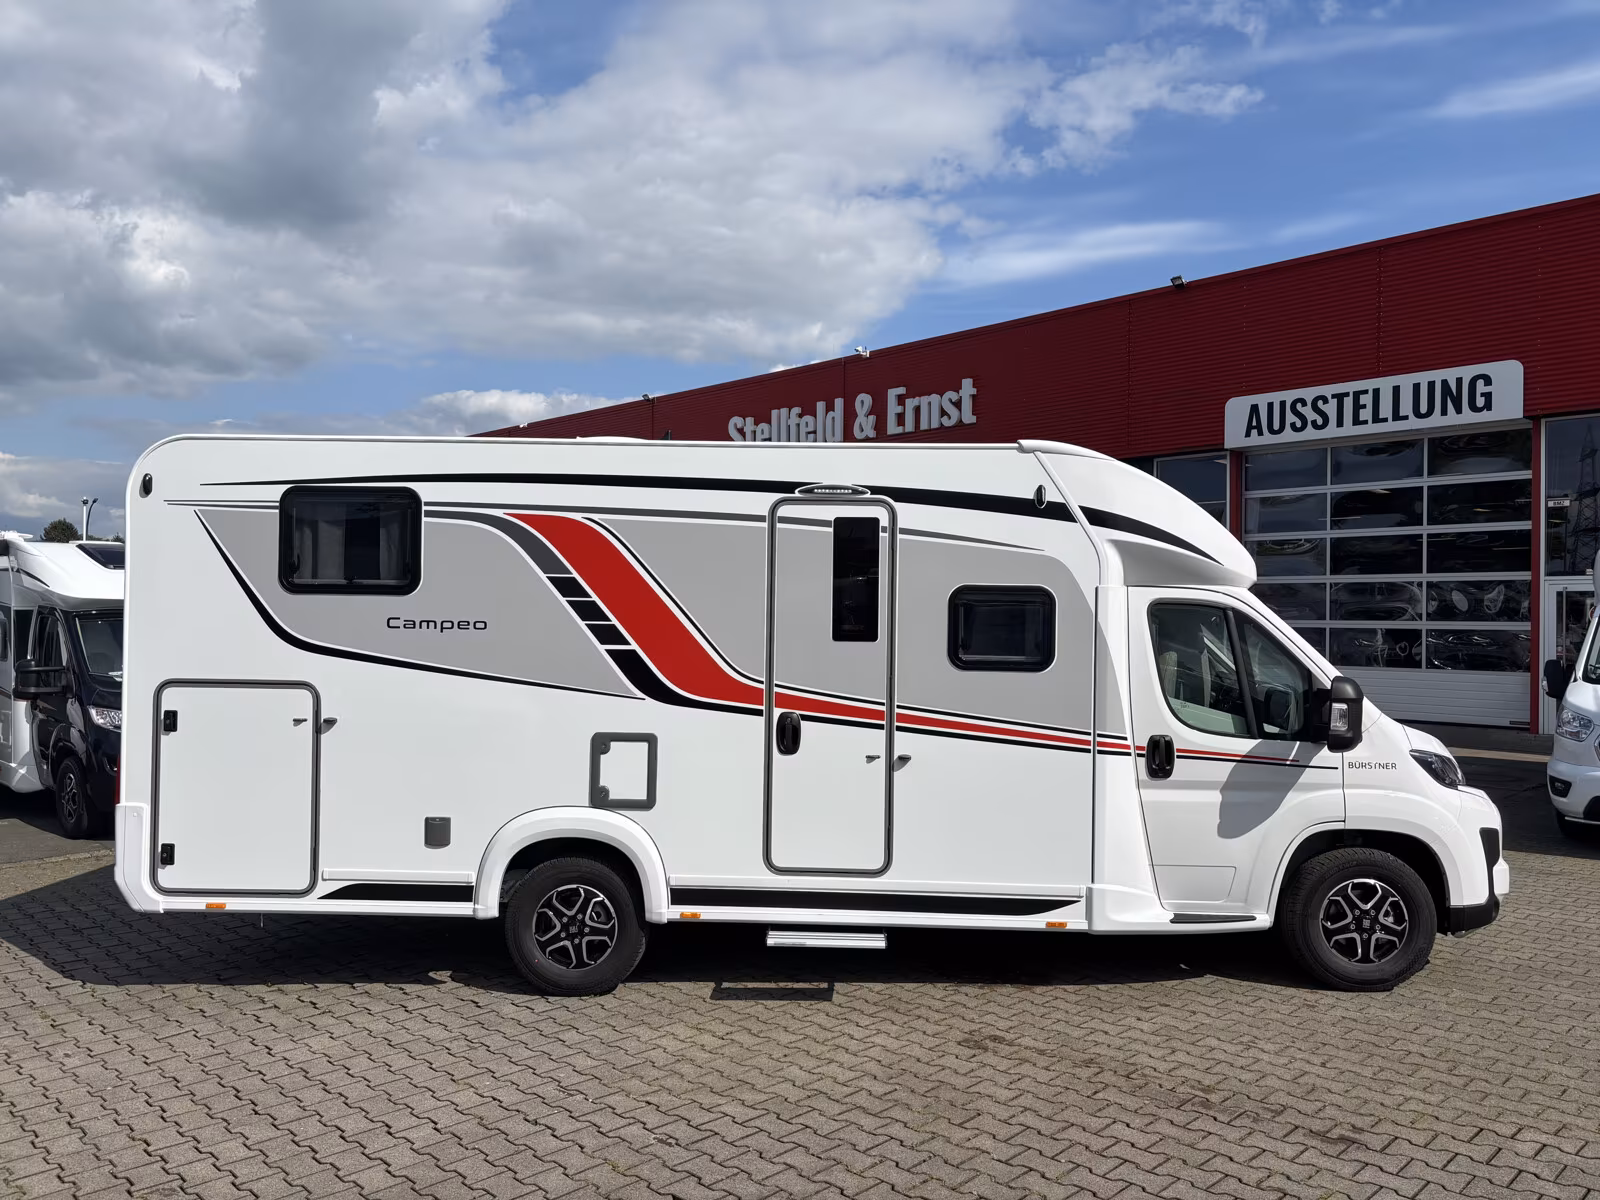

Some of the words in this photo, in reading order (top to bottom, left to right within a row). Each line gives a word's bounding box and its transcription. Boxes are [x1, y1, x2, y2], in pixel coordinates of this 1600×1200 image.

[728, 398, 844, 442] Stellfeld
[853, 393, 876, 440] &
[887, 378, 977, 435] Ernst
[1244, 373, 1493, 438] AUSSTELLUNG
[386, 616, 488, 633] Campeo
[1348, 760, 1397, 770] BÜRSTNER
